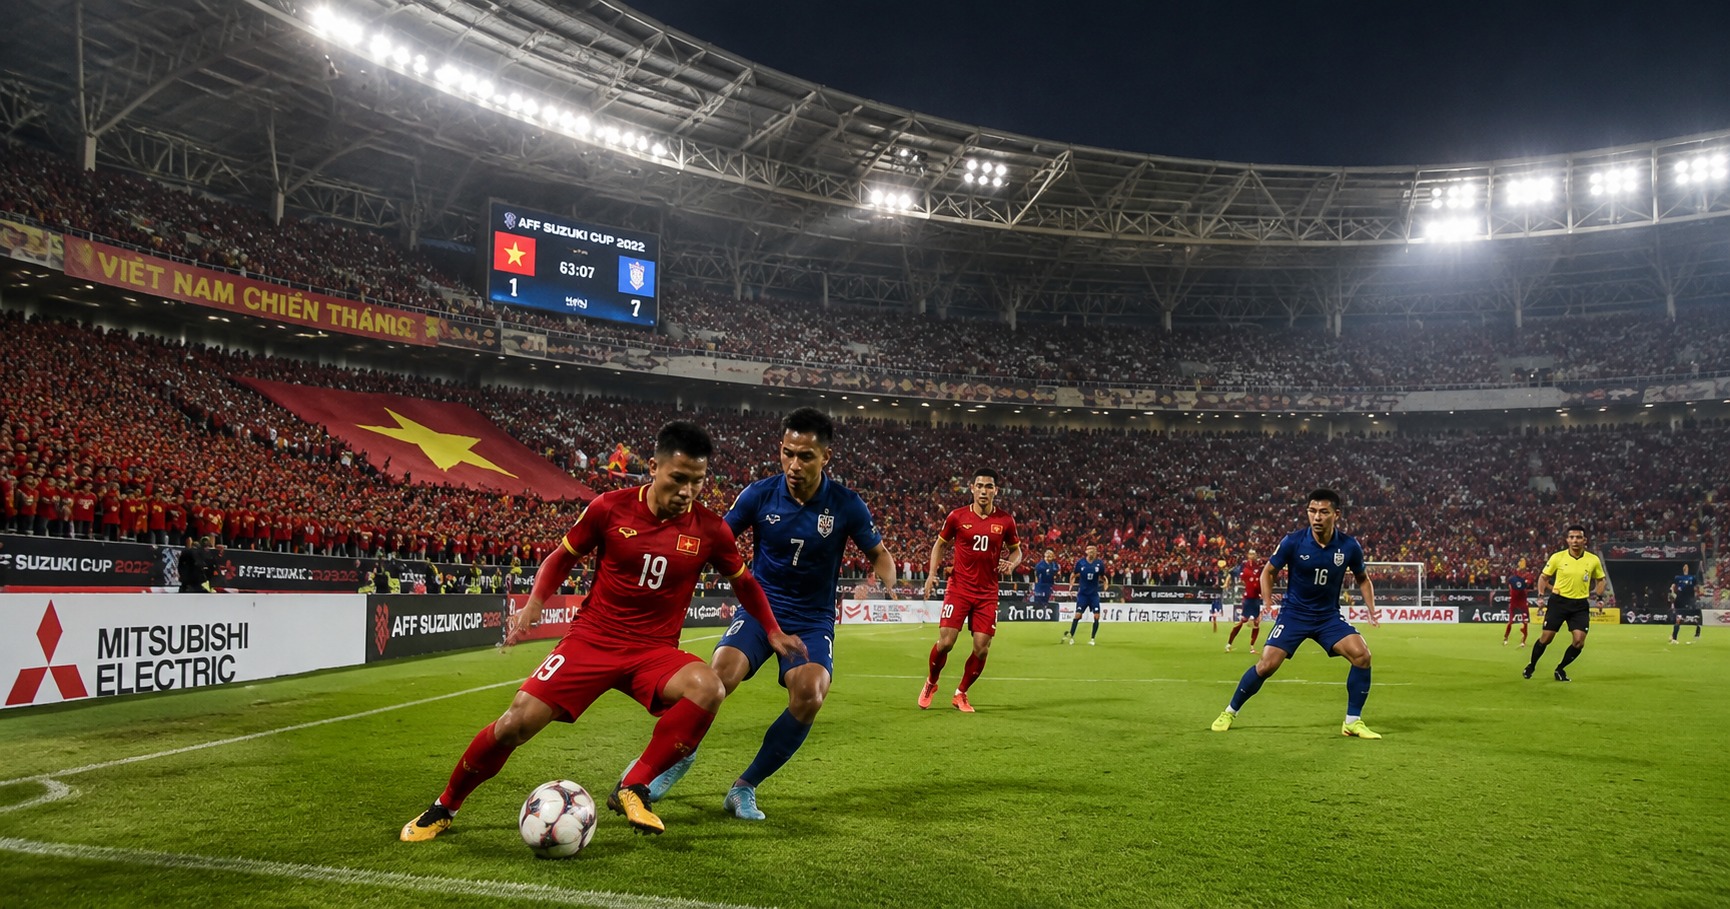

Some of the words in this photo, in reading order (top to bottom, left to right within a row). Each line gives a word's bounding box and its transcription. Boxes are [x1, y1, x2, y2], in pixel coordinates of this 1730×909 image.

[518, 217, 541, 231] AFF
[543, 222, 588, 240] SUZUKI
[590, 232, 615, 245] CUP
[616, 238, 645, 252] 2022
[559, 261, 595, 279] 63:07
[173, 270, 235, 305] NAM
[509, 277, 518, 297] 1
[630, 299, 641, 317] 7
[790, 538, 804, 566] 7
[973, 535, 989, 552] 20
[15, 554, 77, 572] SUZUKI
[80, 558, 112, 573] CUP
[638, 553, 668, 590] 19
[1313, 568, 1328, 586] 16
[391, 615, 418, 638] AFF
[420, 613, 462, 634] SUZUKI
[463, 612, 482, 629] CUP
[97, 622, 249, 660] MITSUBISHI
[96, 654, 236, 697] ELECTRIC
[531, 654, 566, 682] 19
